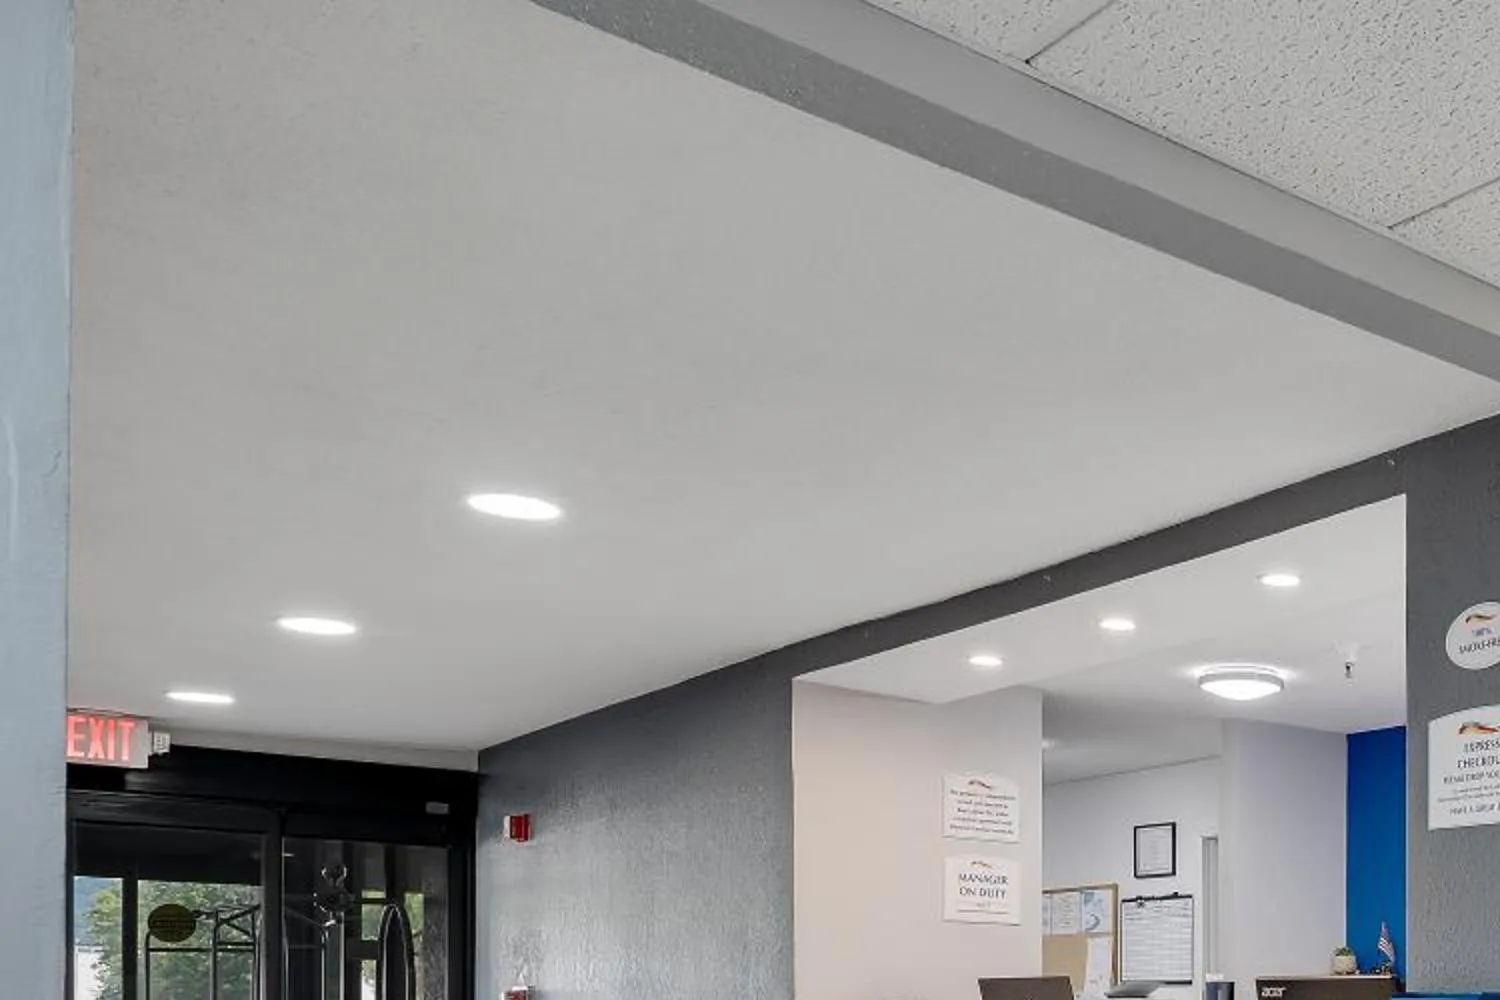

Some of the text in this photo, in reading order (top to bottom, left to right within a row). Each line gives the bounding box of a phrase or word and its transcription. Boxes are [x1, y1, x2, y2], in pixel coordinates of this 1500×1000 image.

[67, 715, 136, 761] EXIT
[1463, 739, 1500, 753] EXPRESS
[959, 873, 1008, 885] MANAGER
[959, 886, 1006, 899] ON DUTY
[1261, 986, 1287, 998] acer
